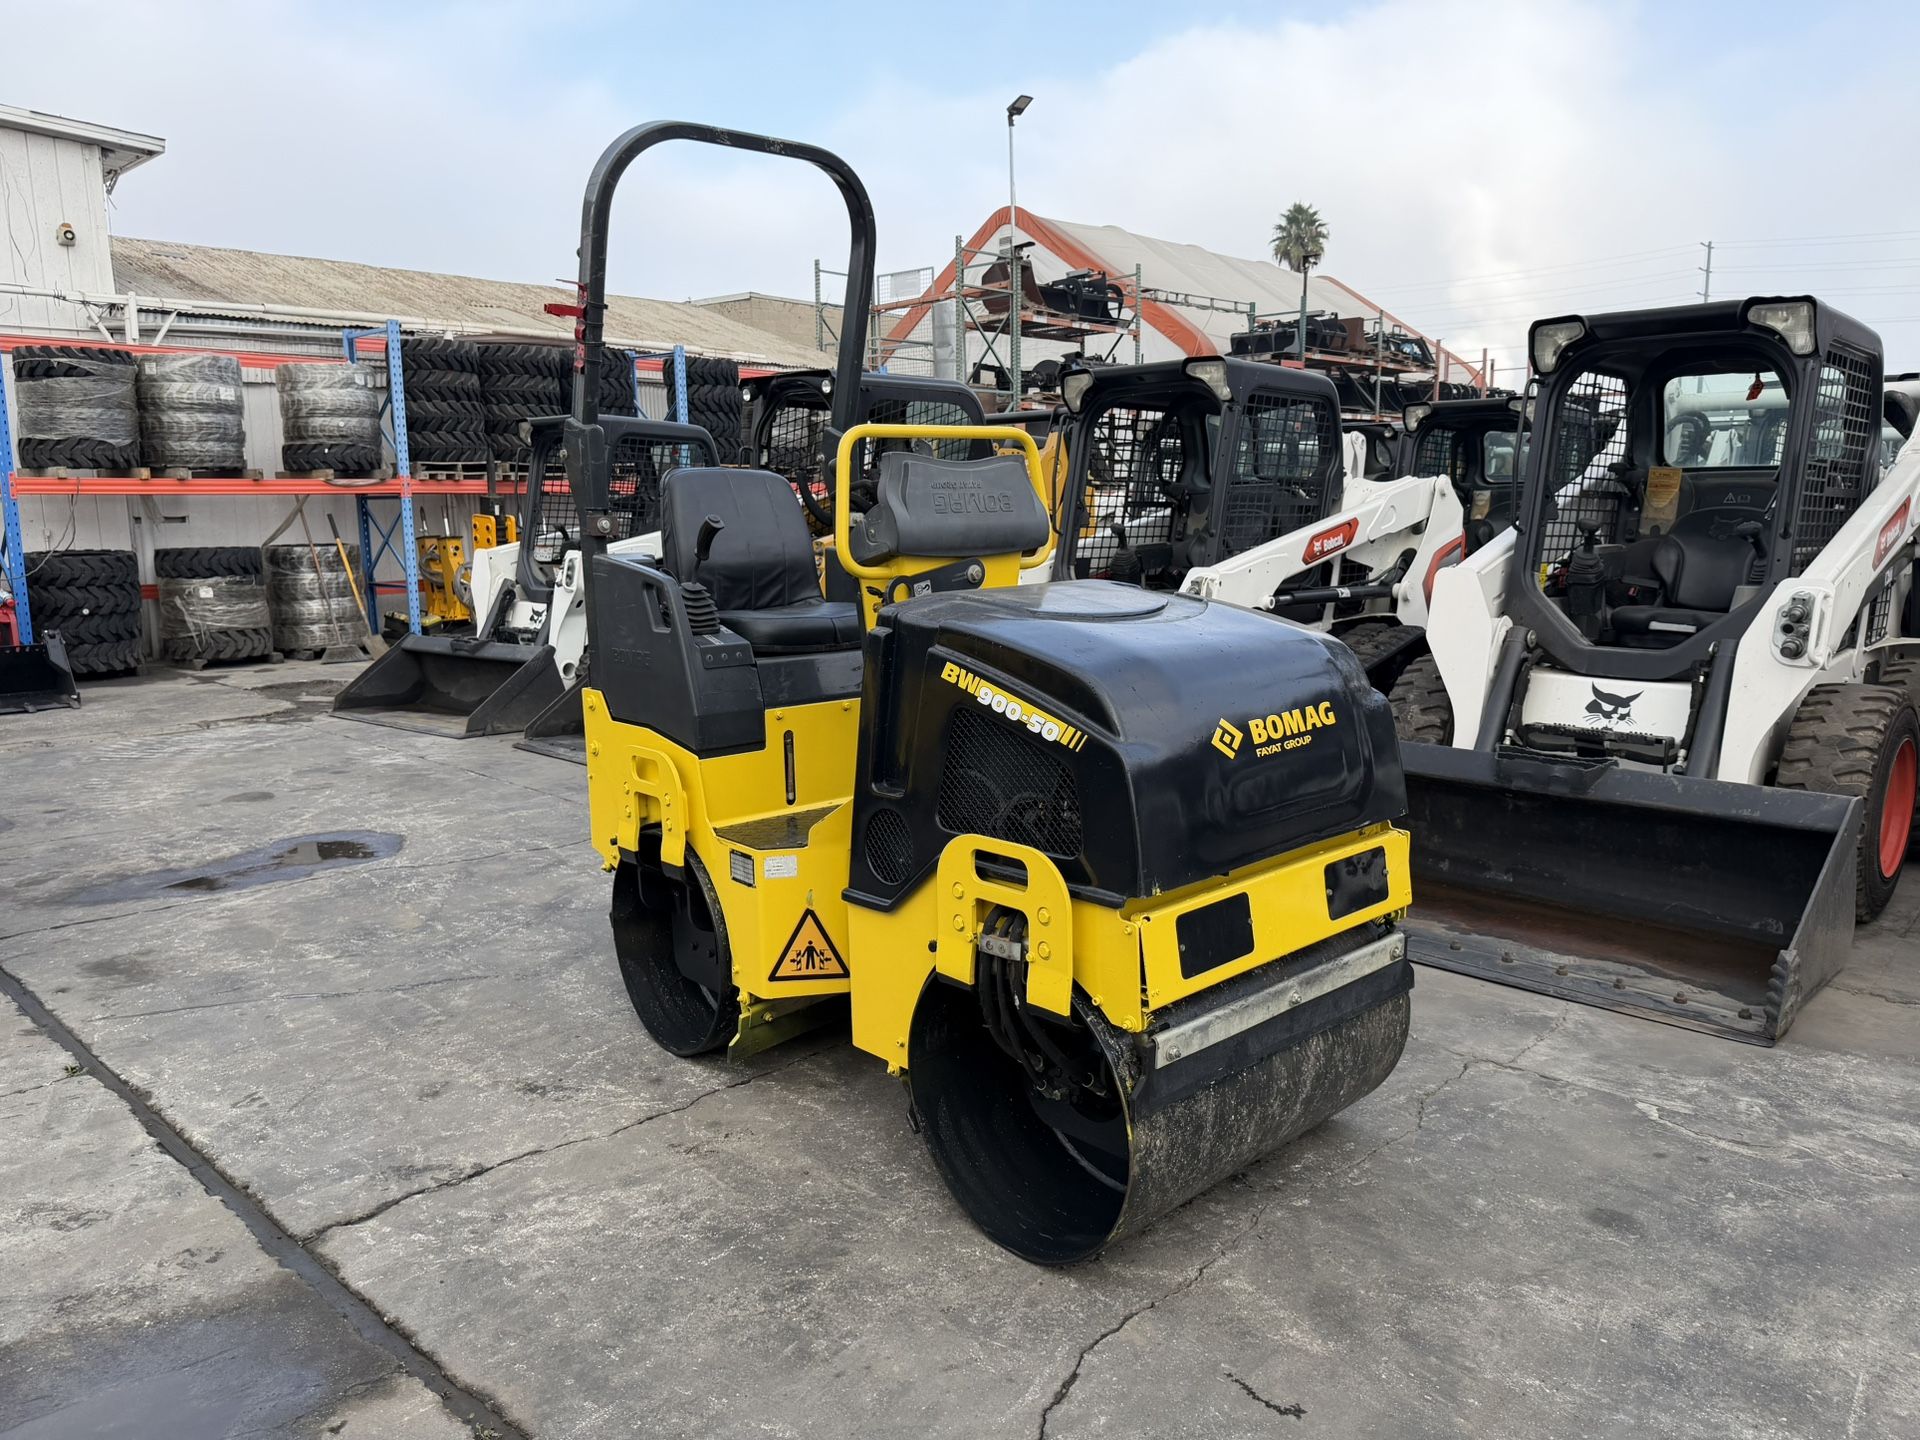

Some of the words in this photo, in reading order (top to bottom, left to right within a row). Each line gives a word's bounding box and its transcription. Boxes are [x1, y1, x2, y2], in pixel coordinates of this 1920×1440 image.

[931, 491, 1014, 514] BOMAG
[1323, 532, 1343, 552] Bobcat
[1248, 701, 1336, 745] BOMAG
[1256, 743, 1282, 758] FAYAT
[1283, 735, 1312, 750] GROUP
